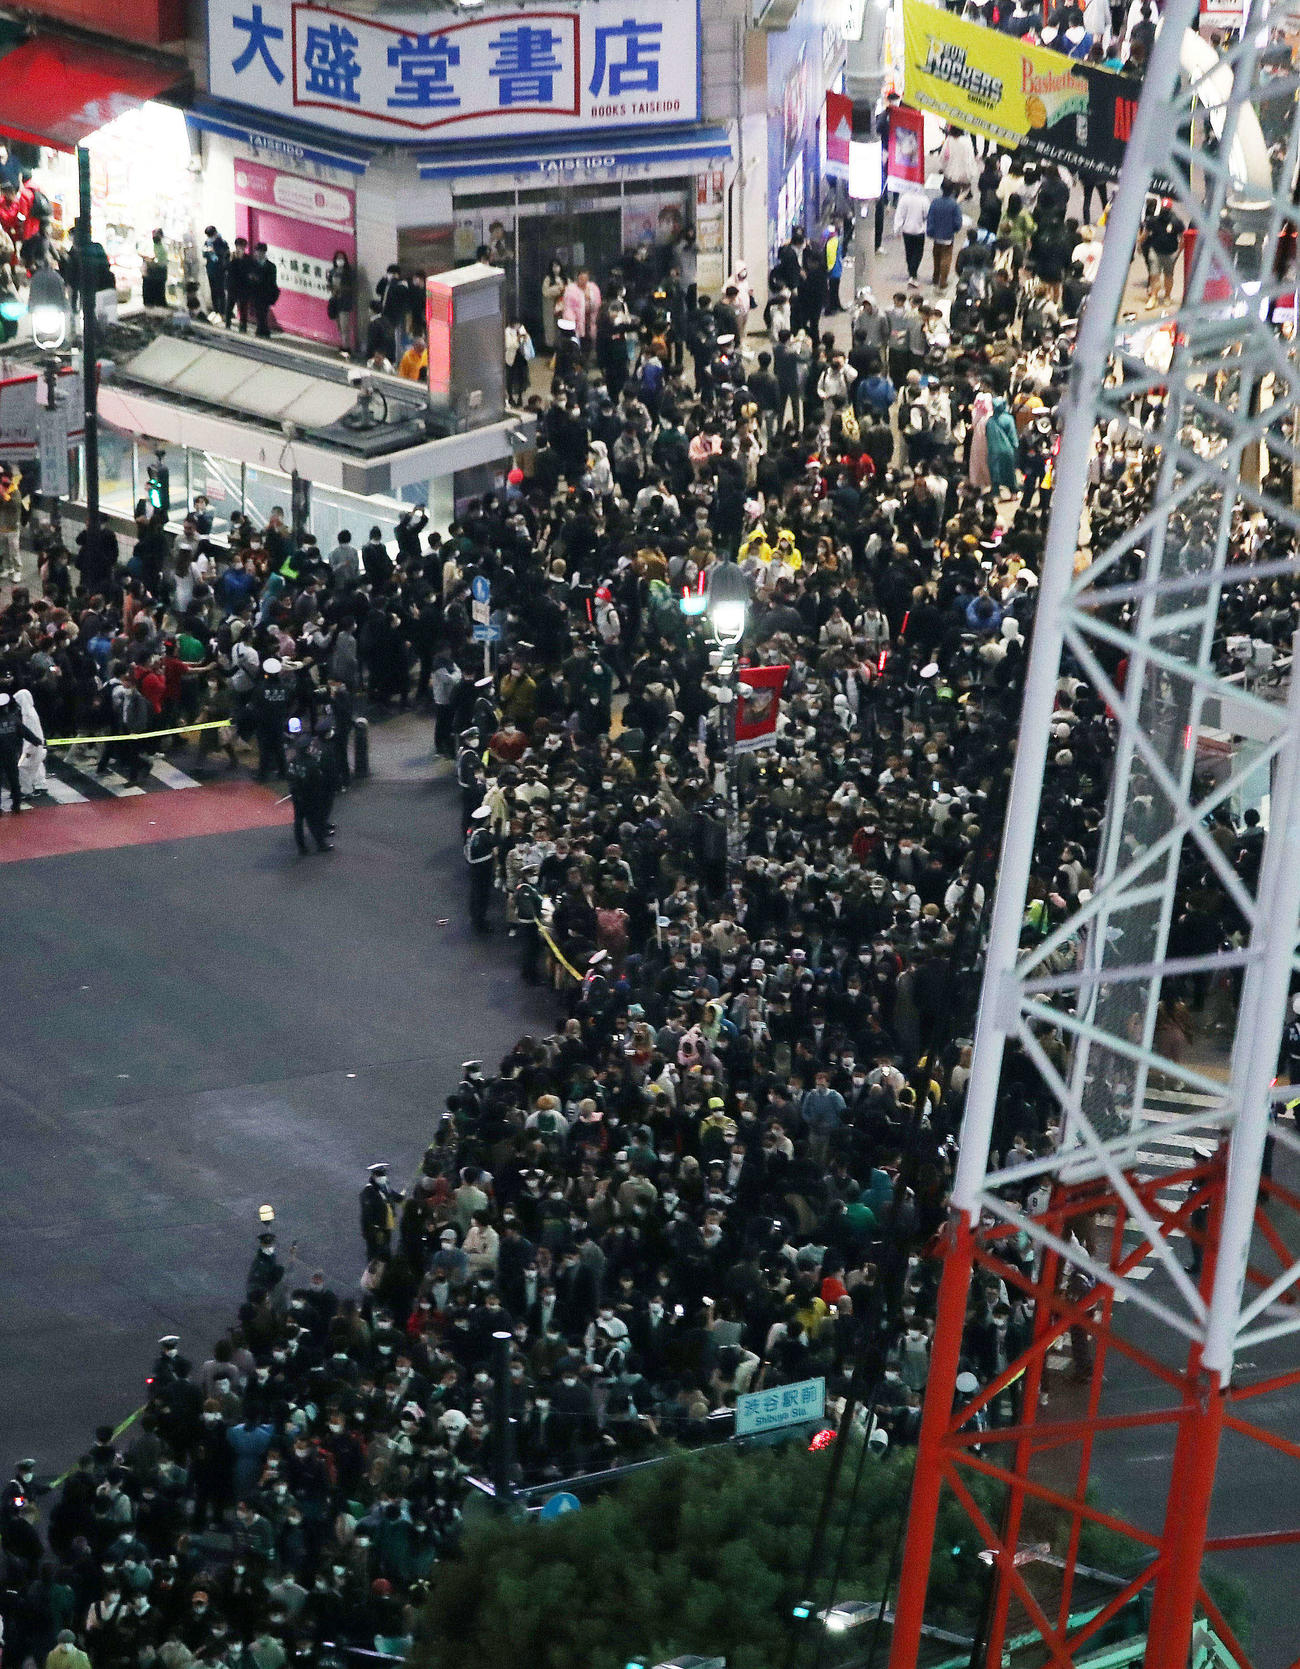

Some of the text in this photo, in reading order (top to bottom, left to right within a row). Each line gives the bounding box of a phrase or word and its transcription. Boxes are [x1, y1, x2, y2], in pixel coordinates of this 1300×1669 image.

[231, 5, 663, 107] 大盛堂書店
[914, 37, 1003, 103] ROCKERS
[591, 104, 626, 117] BOOKS
[538, 156, 616, 171] TAISEIDO
[744, 1386, 817, 1416] 渋谷駅前
[756, 1412, 789, 1426] Shibuya
